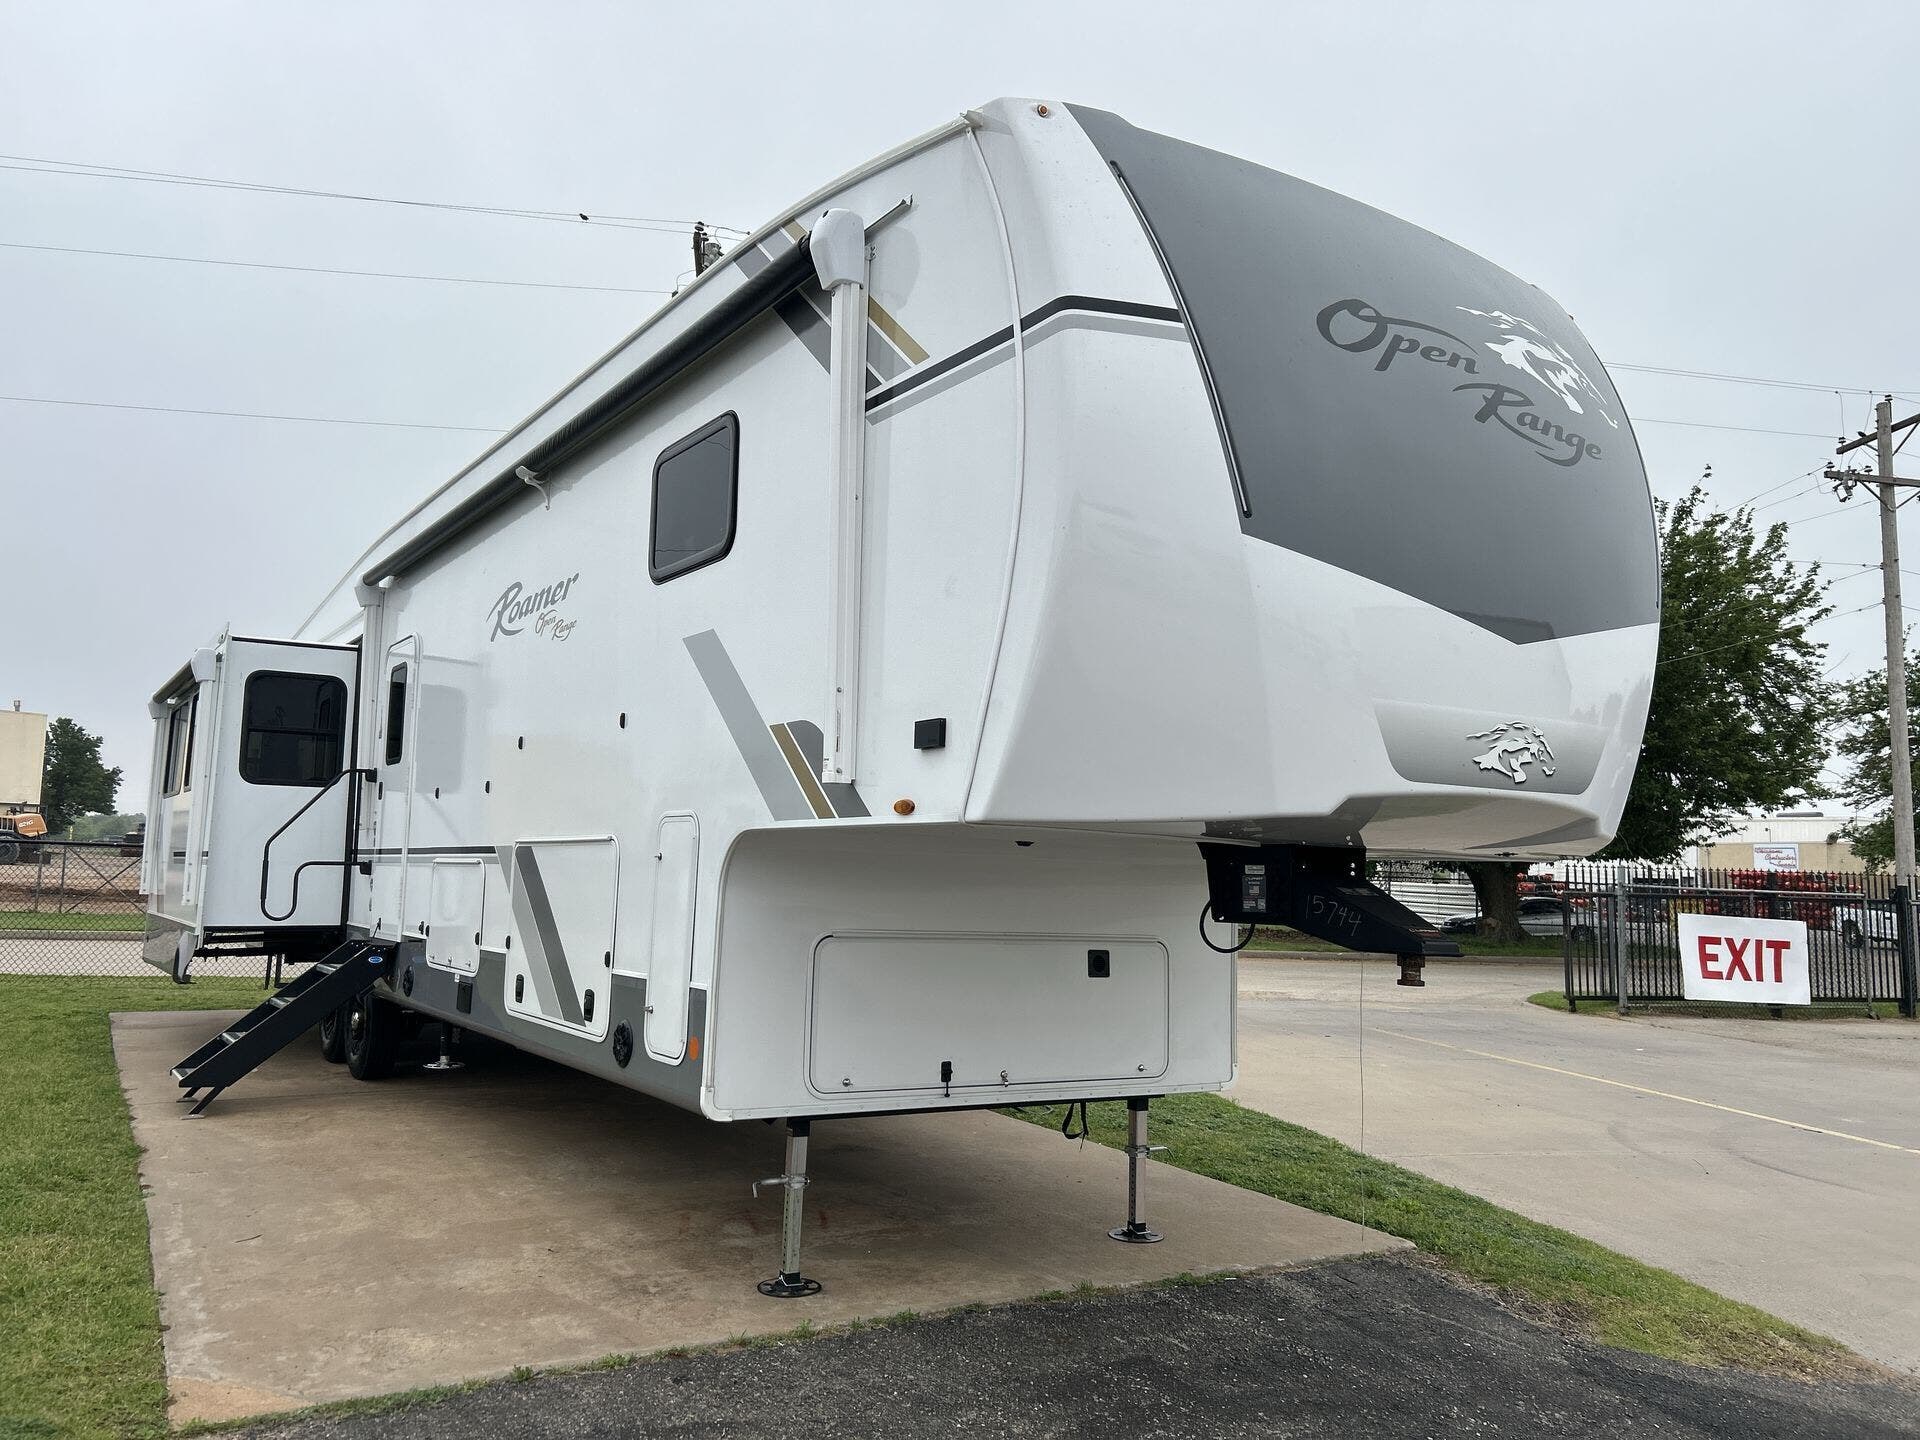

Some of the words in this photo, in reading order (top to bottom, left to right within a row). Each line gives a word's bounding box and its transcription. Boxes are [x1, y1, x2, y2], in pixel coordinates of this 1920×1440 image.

[1316, 299, 1480, 375] Open
[1452, 383, 1603, 467] Range
[486, 573, 580, 642] Roamer
[551, 619, 577, 641] Range
[1305, 895, 1362, 937] 15744
[1697, 936, 1791, 984] EXIT
